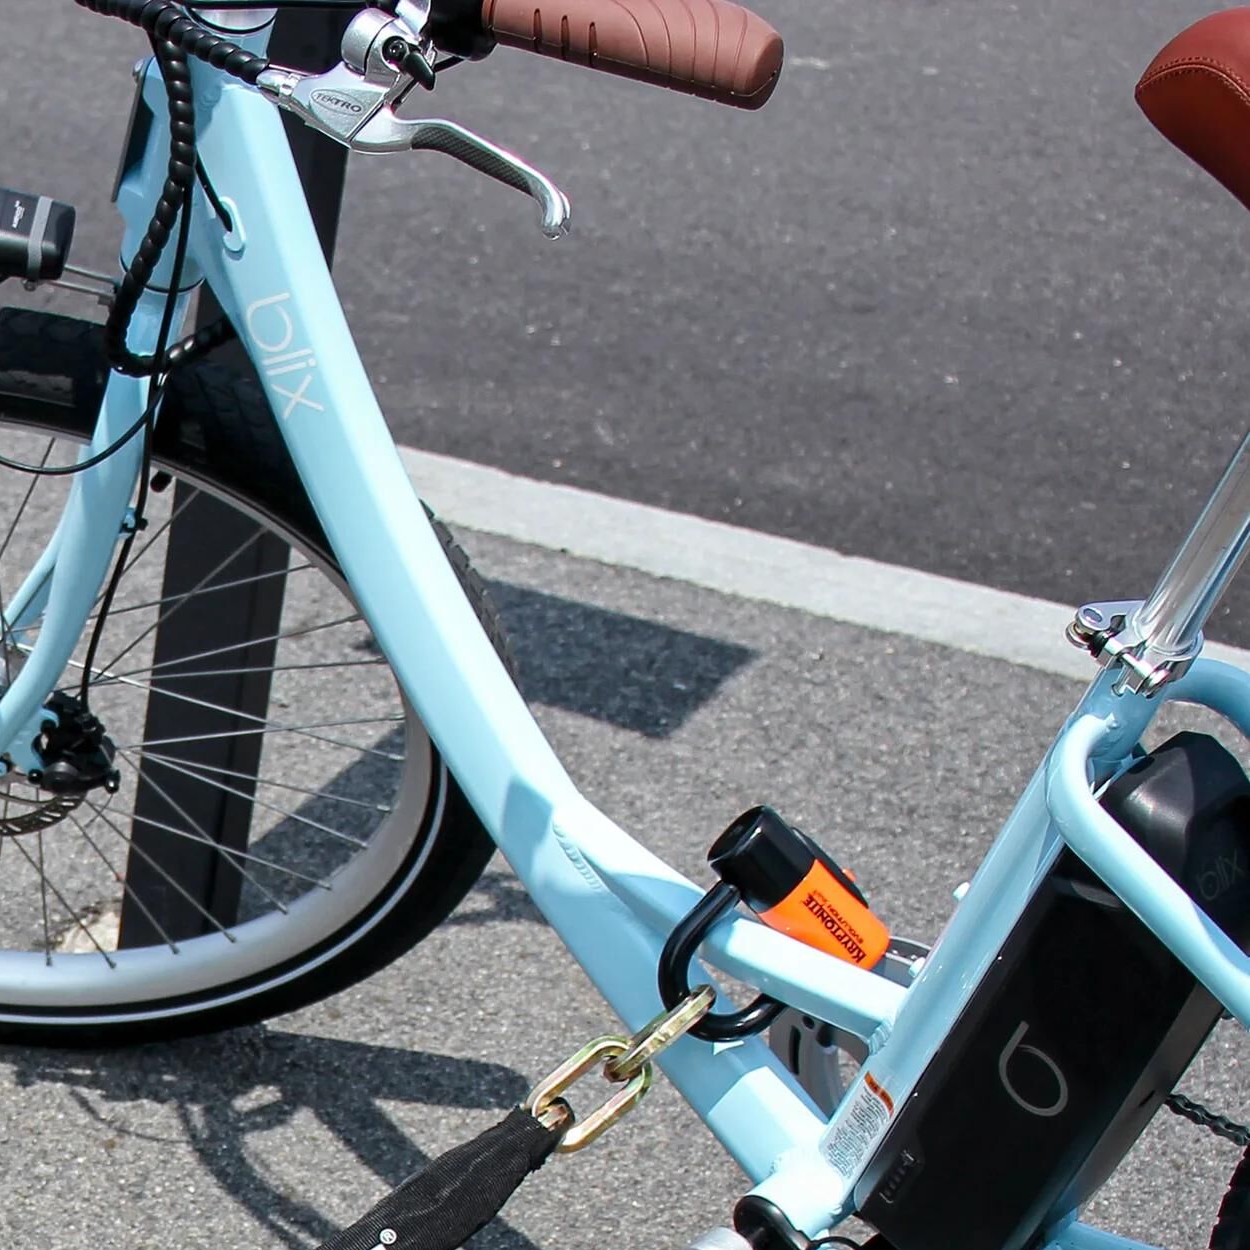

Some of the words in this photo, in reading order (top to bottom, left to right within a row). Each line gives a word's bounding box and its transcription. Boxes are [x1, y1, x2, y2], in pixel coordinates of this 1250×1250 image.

[315, 92, 363, 113] TEKTRO
[246, 292, 325, 420] blix
[801, 891, 867, 964] KRYPTONITE
